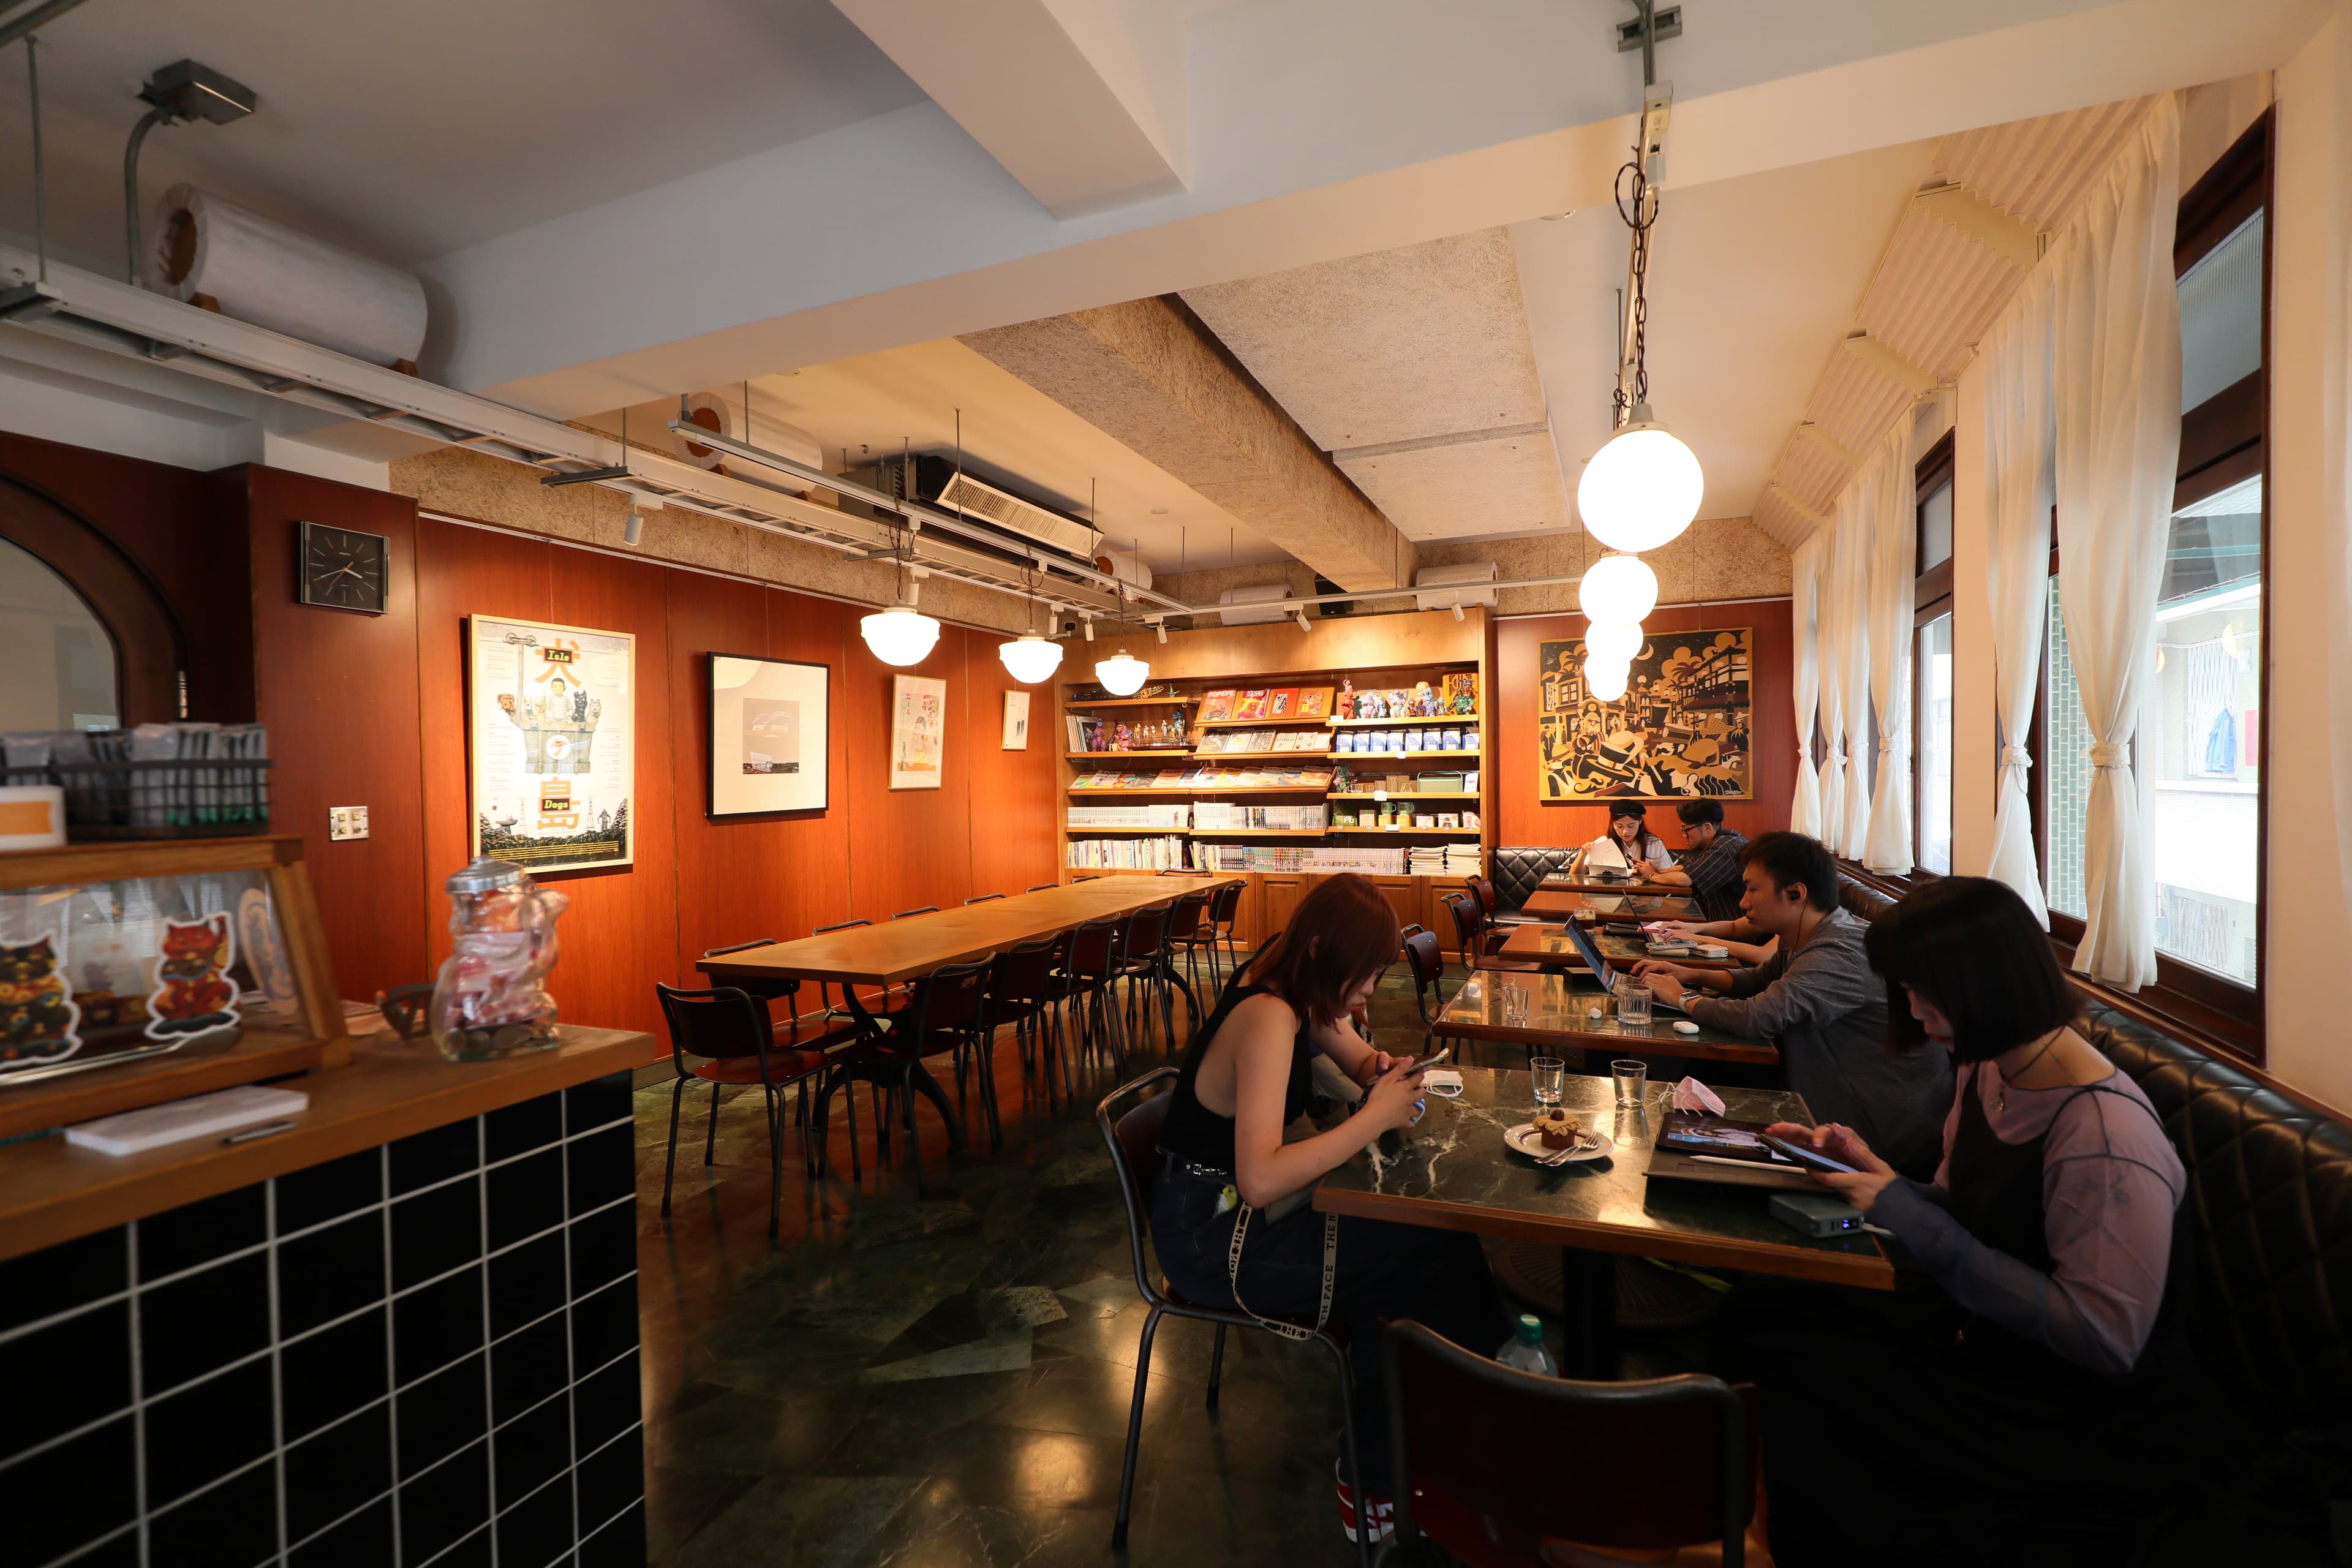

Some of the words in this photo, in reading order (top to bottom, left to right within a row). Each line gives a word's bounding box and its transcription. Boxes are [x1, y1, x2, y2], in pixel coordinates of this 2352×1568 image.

[535, 638, 581, 687] 犬
[547, 650, 570, 662] Isle
[537, 776, 581, 830] 島
[544, 799, 569, 810] Dogs
[1327, 1225, 1335, 1250] THE
[1324, 1265, 1333, 1300] FACE
